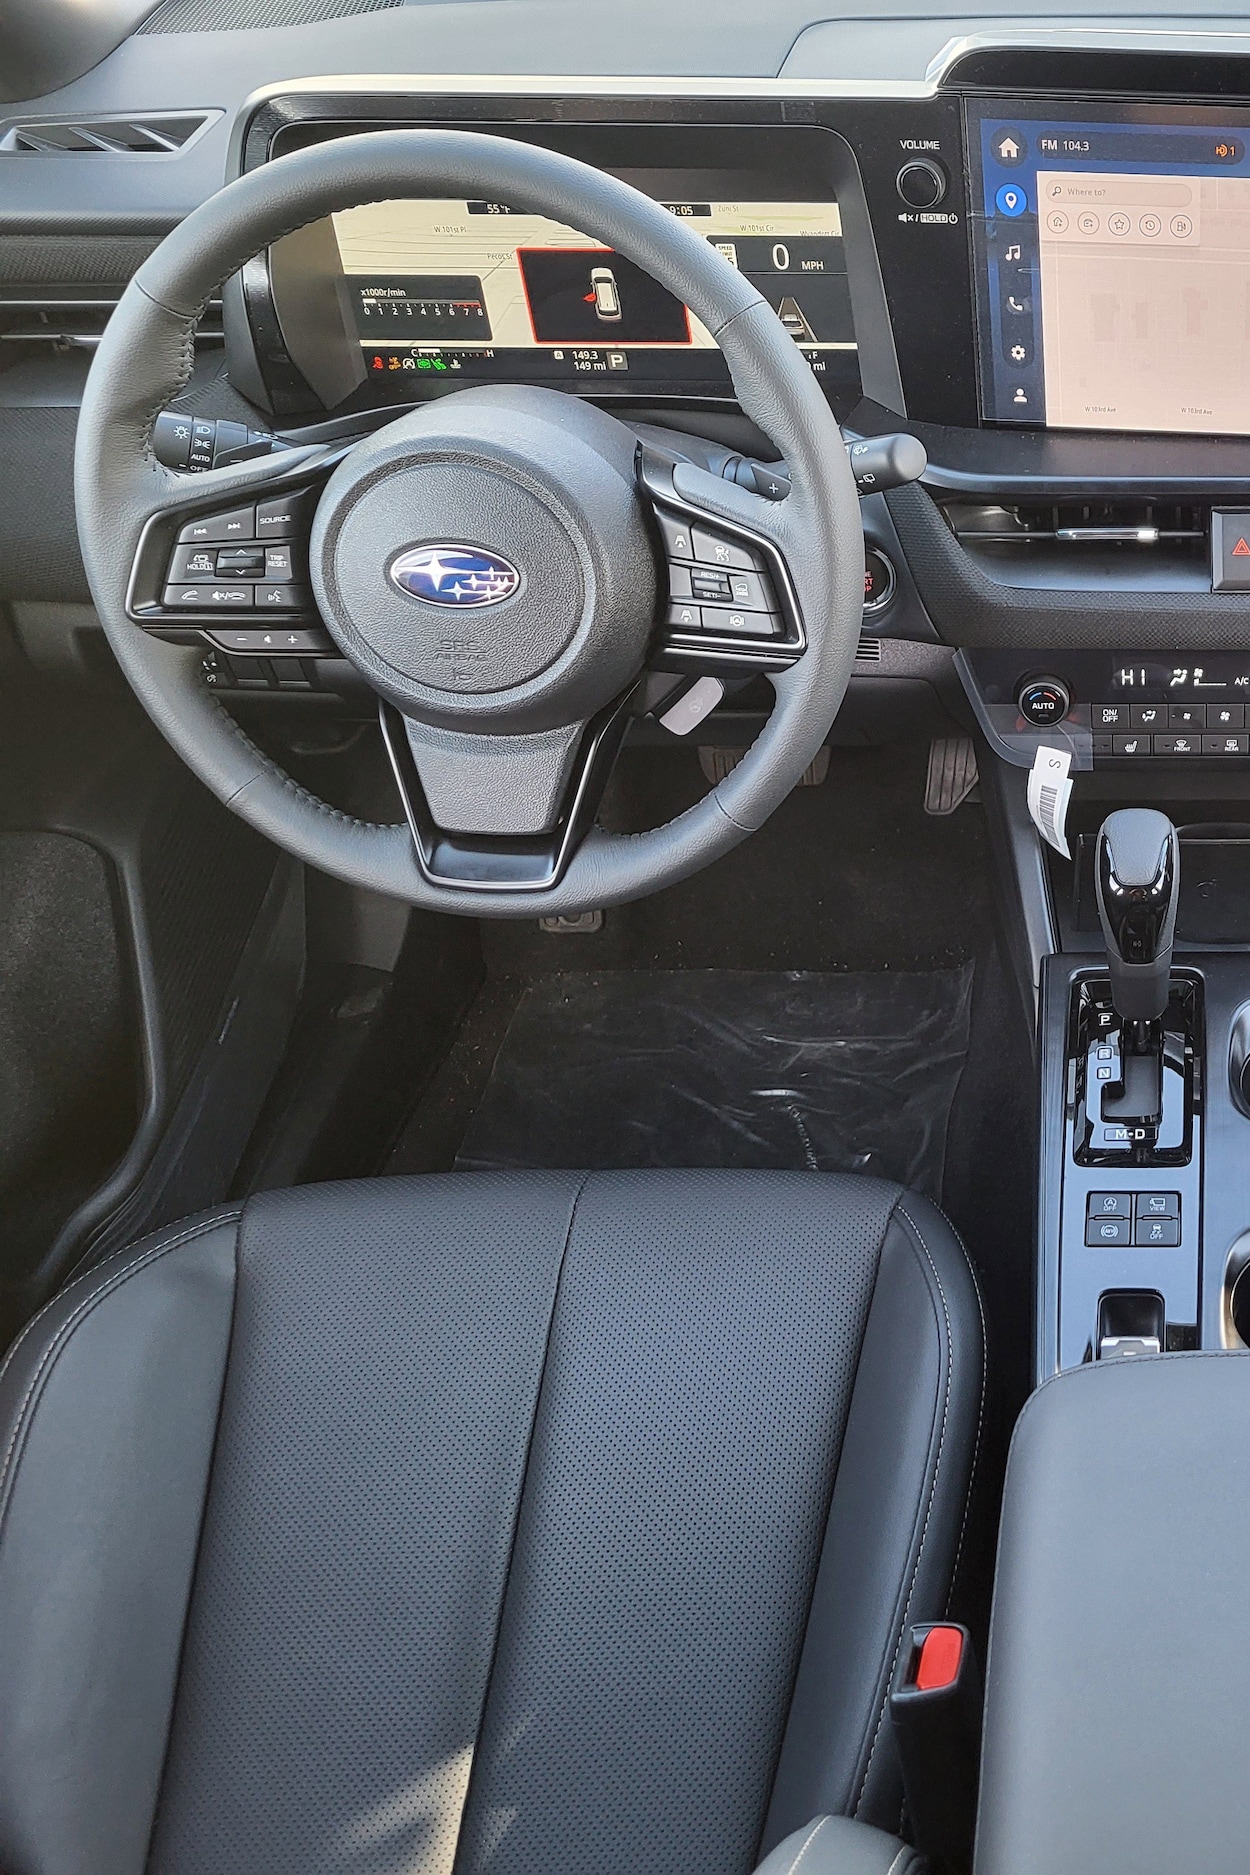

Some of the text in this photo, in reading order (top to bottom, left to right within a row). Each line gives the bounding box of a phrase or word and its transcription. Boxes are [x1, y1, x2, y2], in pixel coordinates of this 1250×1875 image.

[900, 140, 940, 150] VOLUME
[1041, 140, 1089, 151] FM 104.3
[1067, 187, 1106, 197] Where to?
[920, 213, 948, 224] HOLD
[772, 243, 790, 271] 0
[801, 261, 824, 270] MPH
[364, 308, 484, 316] 0 1 2 3 4 5 6 7 8
[411, 349, 418, 357] C
[486, 350, 494, 358] H
[572, 350, 598, 360] 149.3
[574, 361, 607, 371] 149 mi
[610, 354, 623, 368] P
[190, 453, 210, 463] AUTO
[259, 514, 291, 525] SOURCE
[267, 560, 288, 568] RESET
[1234, 677, 1249, 686] A/C
[1032, 702, 1055, 710] AUTO
[1102, 708, 1118, 716] ON/
[1102, 715, 1119, 723] OFF
[1048, 758, 1062, 769] S
[1100, 1015, 1110, 1025] P
[1115, 1128, 1146, 1140] M-D
